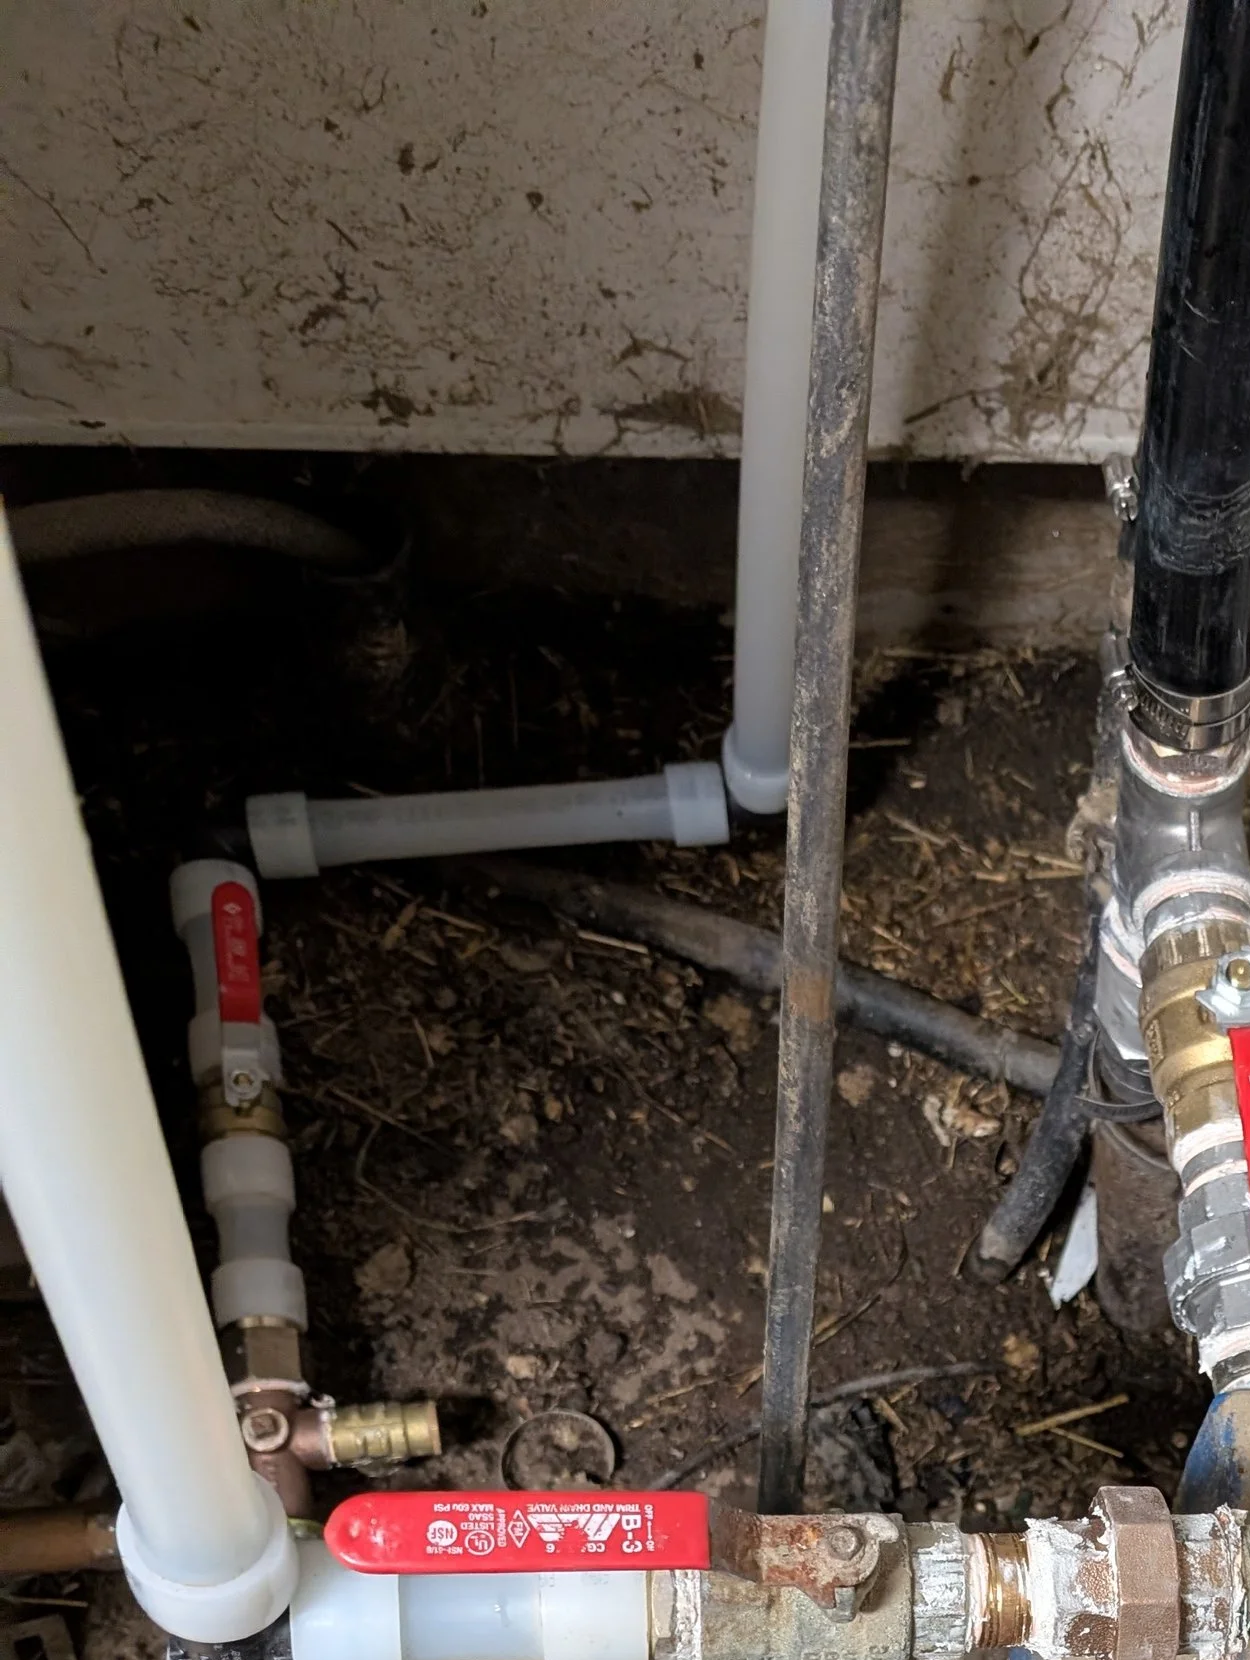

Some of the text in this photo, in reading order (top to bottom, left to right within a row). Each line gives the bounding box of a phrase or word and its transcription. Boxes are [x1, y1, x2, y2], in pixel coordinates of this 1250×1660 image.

[432, 1503, 450, 1511] PSI
[470, 1503, 493, 1511] MAX
[526, 1503, 640, 1512] TRIM AND DRAIN VALVE
[460, 1521, 494, 1529] LISTED
[496, 1508, 506, 1547] APPROVED
[429, 1526, 454, 1540] NSF
[621, 1514, 641, 1553] B-3
